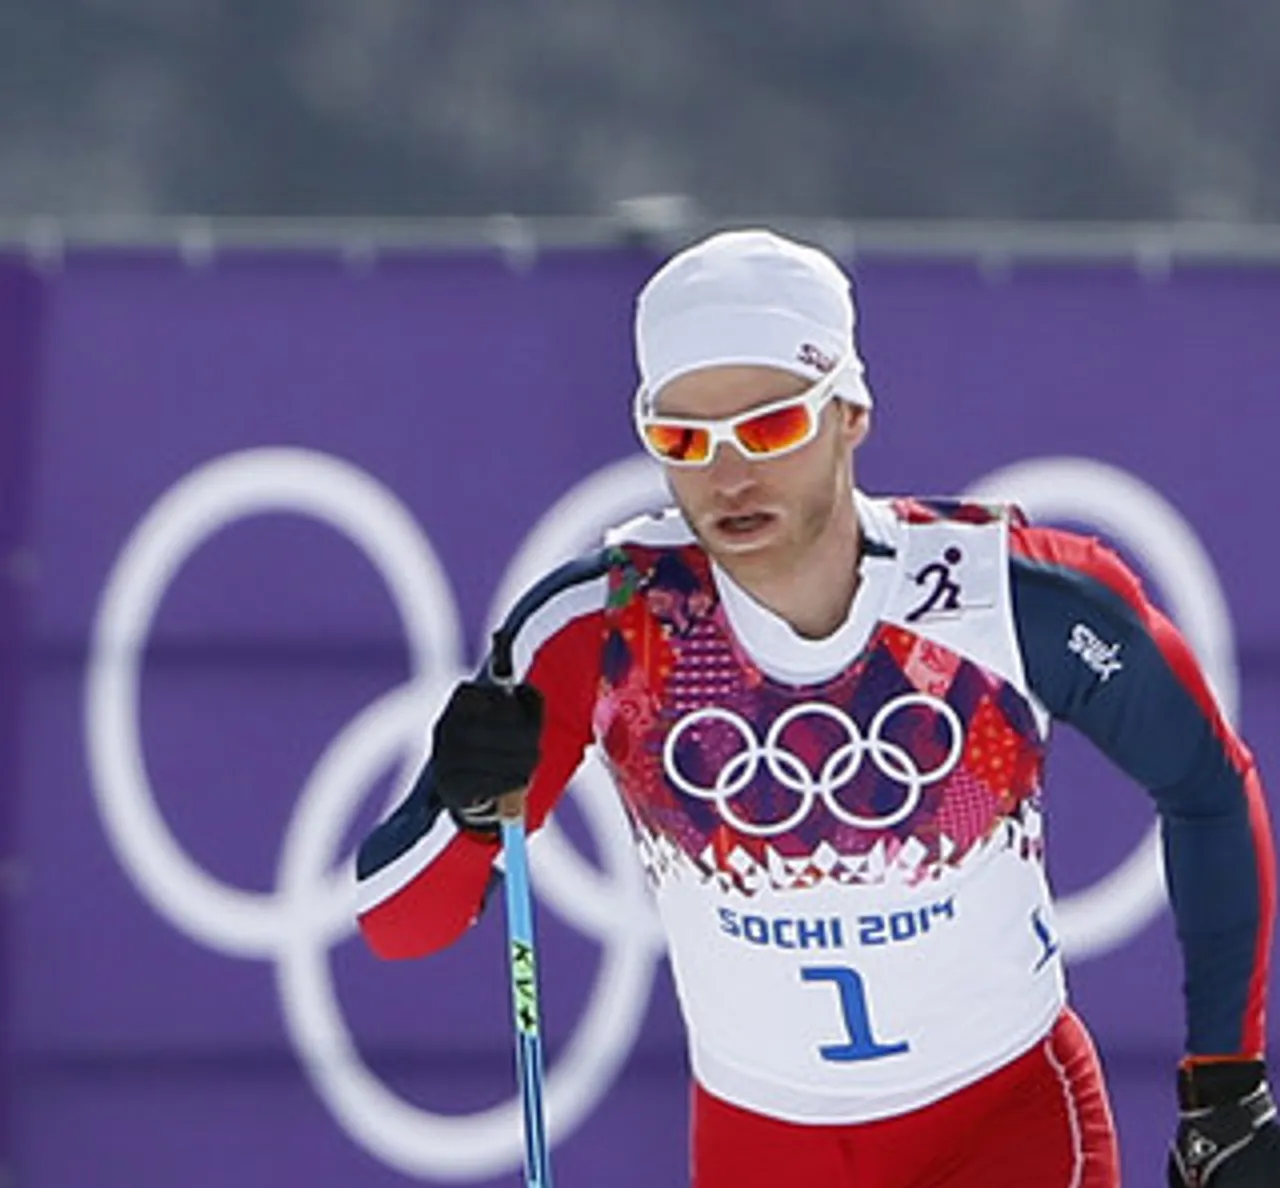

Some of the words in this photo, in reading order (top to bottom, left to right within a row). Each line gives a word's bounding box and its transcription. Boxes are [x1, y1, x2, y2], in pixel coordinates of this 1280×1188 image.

[716, 905, 845, 949] SOCHI
[857, 895, 956, 946] 2014
[799, 966, 910, 1062] 1
